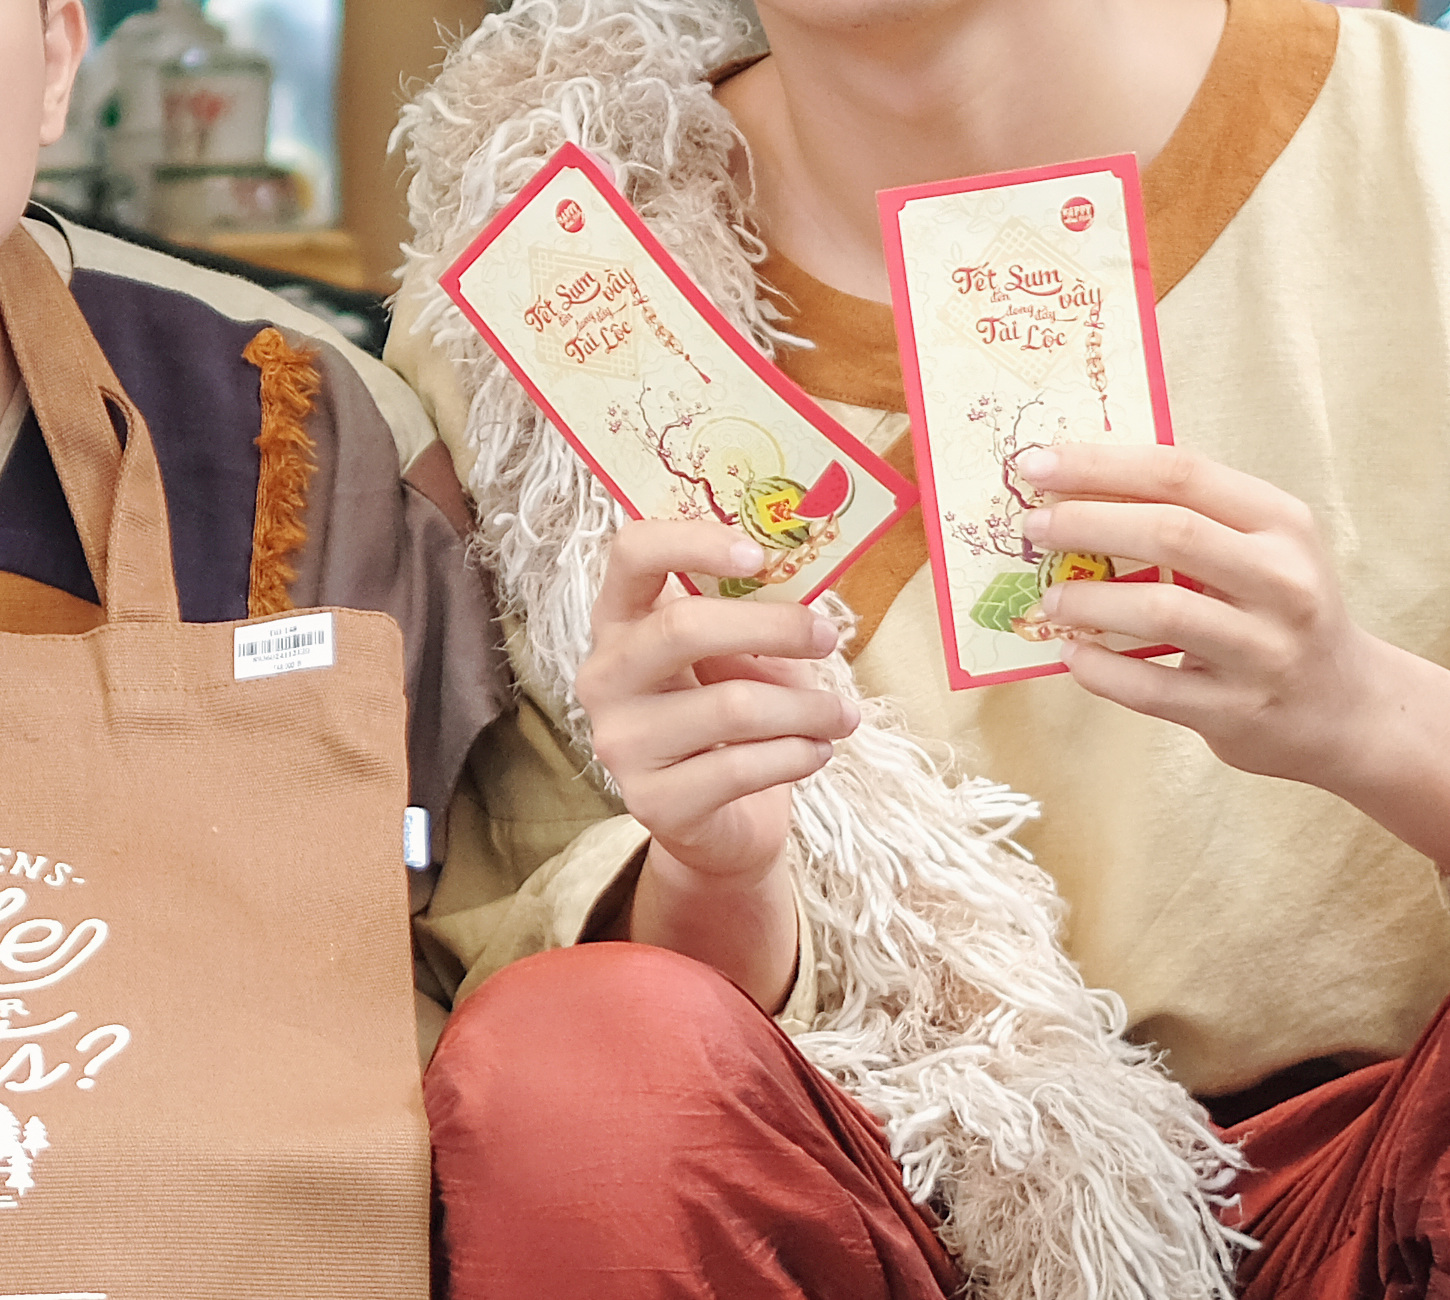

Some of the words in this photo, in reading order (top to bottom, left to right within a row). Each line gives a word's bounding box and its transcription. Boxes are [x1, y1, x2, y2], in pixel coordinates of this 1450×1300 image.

[555, 271, 601, 311] Sum
[952, 262, 997, 294] Tết
[1004, 264, 1063, 296] Sum
[1058, 278, 1103, 312] vầy
[524, 295, 558, 332] Tết
[976, 317, 1022, 345] Tài
[1020, 325, 1068, 354] Lộc
